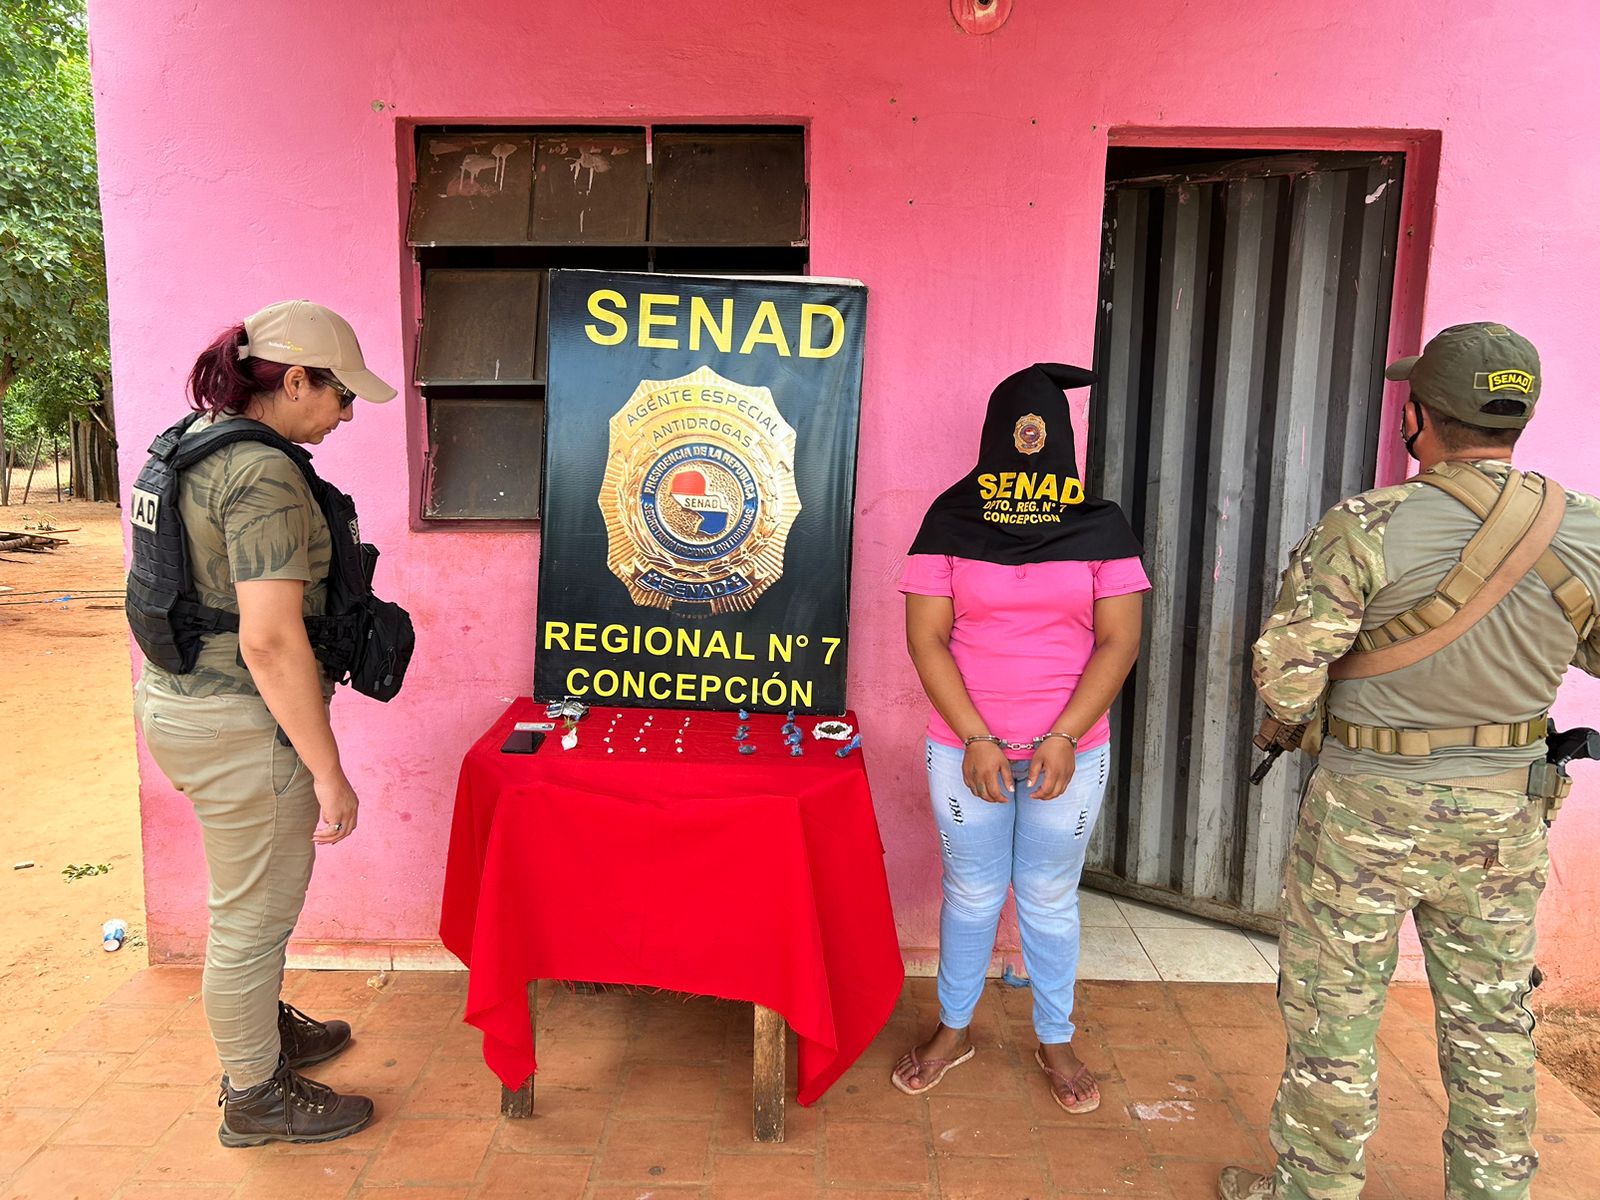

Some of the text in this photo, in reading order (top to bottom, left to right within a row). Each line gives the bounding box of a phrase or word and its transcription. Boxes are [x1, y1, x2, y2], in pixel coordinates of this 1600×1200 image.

[584, 289, 845, 359] SENAD
[1493, 374, 1529, 387] SENAD
[626, 389, 778, 437] AGENTE ESPECIAL
[652, 417, 753, 448] ANTIDROGAS
[643, 447, 692, 494] PRESIDENCIA
[692, 446, 707, 456] DE
[708, 446, 722, 458] LA
[684, 498, 719, 509] SENAD
[977, 472, 1085, 505] SENAD
[983, 500, 1012, 512] DPTO.
[1016, 502, 1039, 512] REG.
[1059, 505, 1067, 513] 7
[983, 512, 1060, 524] CONCEPCION
[659, 577, 727, 597] SENAD
[544, 621, 756, 661] REGIONAL
[821, 637, 841, 665] 7
[566, 668, 813, 708] CONCEPCIÓN
